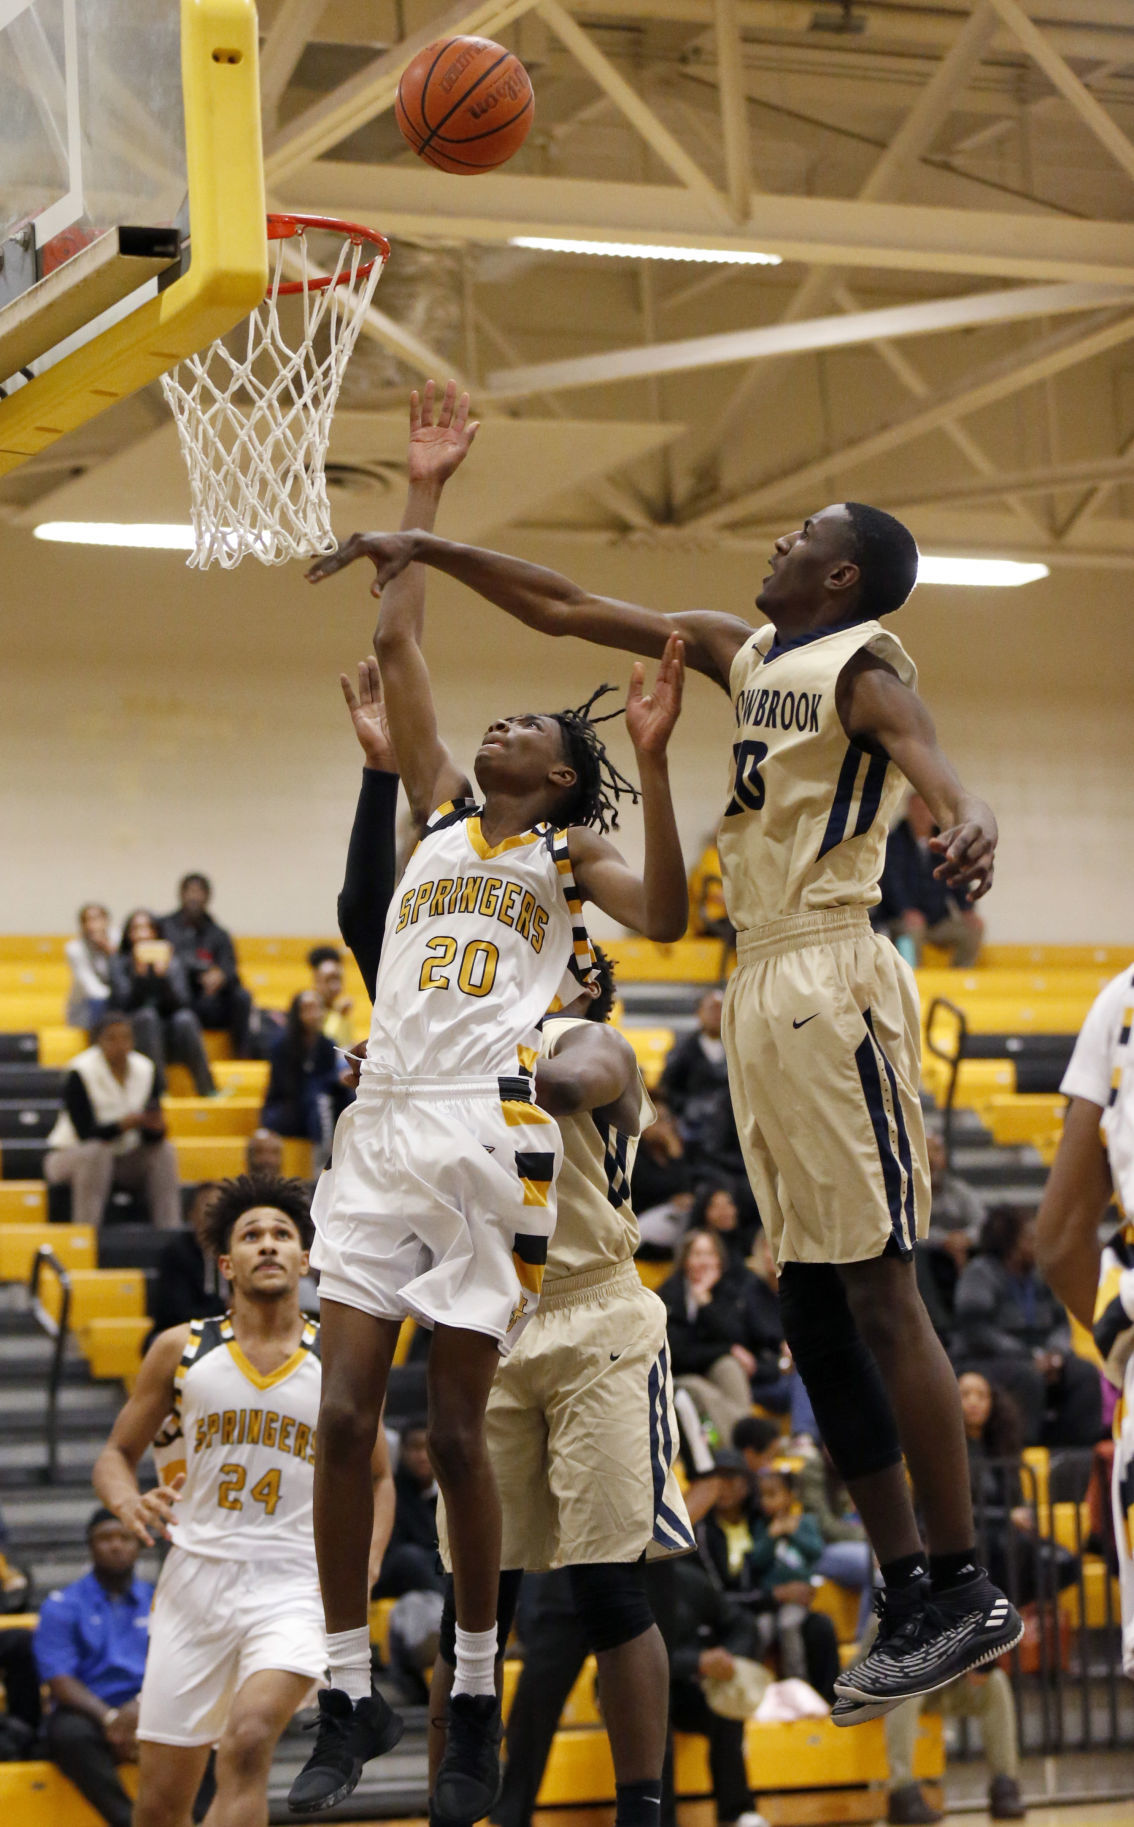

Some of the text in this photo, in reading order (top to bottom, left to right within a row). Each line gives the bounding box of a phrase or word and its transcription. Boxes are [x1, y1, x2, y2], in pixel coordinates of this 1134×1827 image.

[735, 688, 823, 733] OWBROOK
[395, 876, 549, 954] SPRINGERS
[418, 935, 500, 998] 20
[217, 1462, 283, 1516] 24
